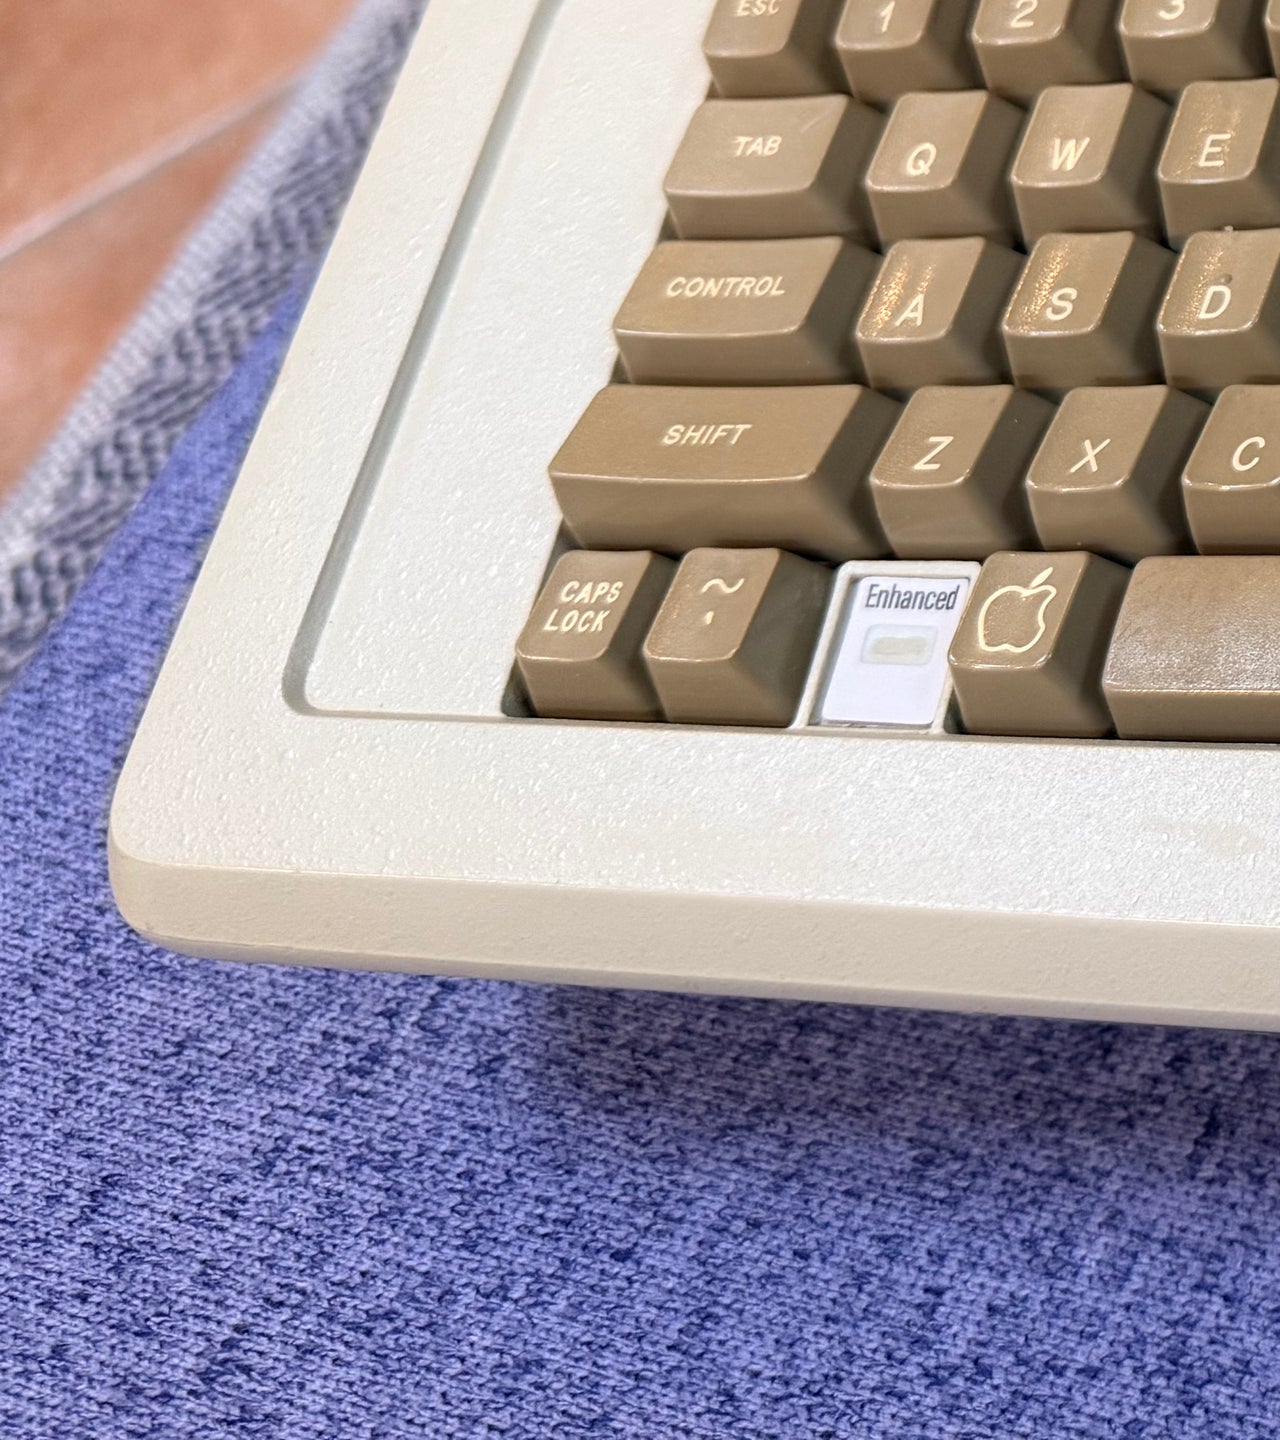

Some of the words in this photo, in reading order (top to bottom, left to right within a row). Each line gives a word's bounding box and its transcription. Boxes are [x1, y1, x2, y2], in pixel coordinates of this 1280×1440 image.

[878, 2, 897, 34] 1
[733, 135, 783, 157] TAB
[905, 142, 937, 177] Q
[1051, 135, 1091, 171] W
[1198, 133, 1232, 168] E
[665, 275, 786, 298] CONTROL
[1198, 284, 1232, 320] D
[894, 294, 925, 327] A
[1044, 287, 1078, 321] S
[661, 423, 753, 446] SHIFT
[913, 436, 955, 471] Z
[1069, 438, 1112, 474] X
[1231, 435, 1267, 471] C
[559, 580, 624, 604] CAPS
[864, 583, 960, 612] Enhanced
[543, 608, 608, 633] LOCK
